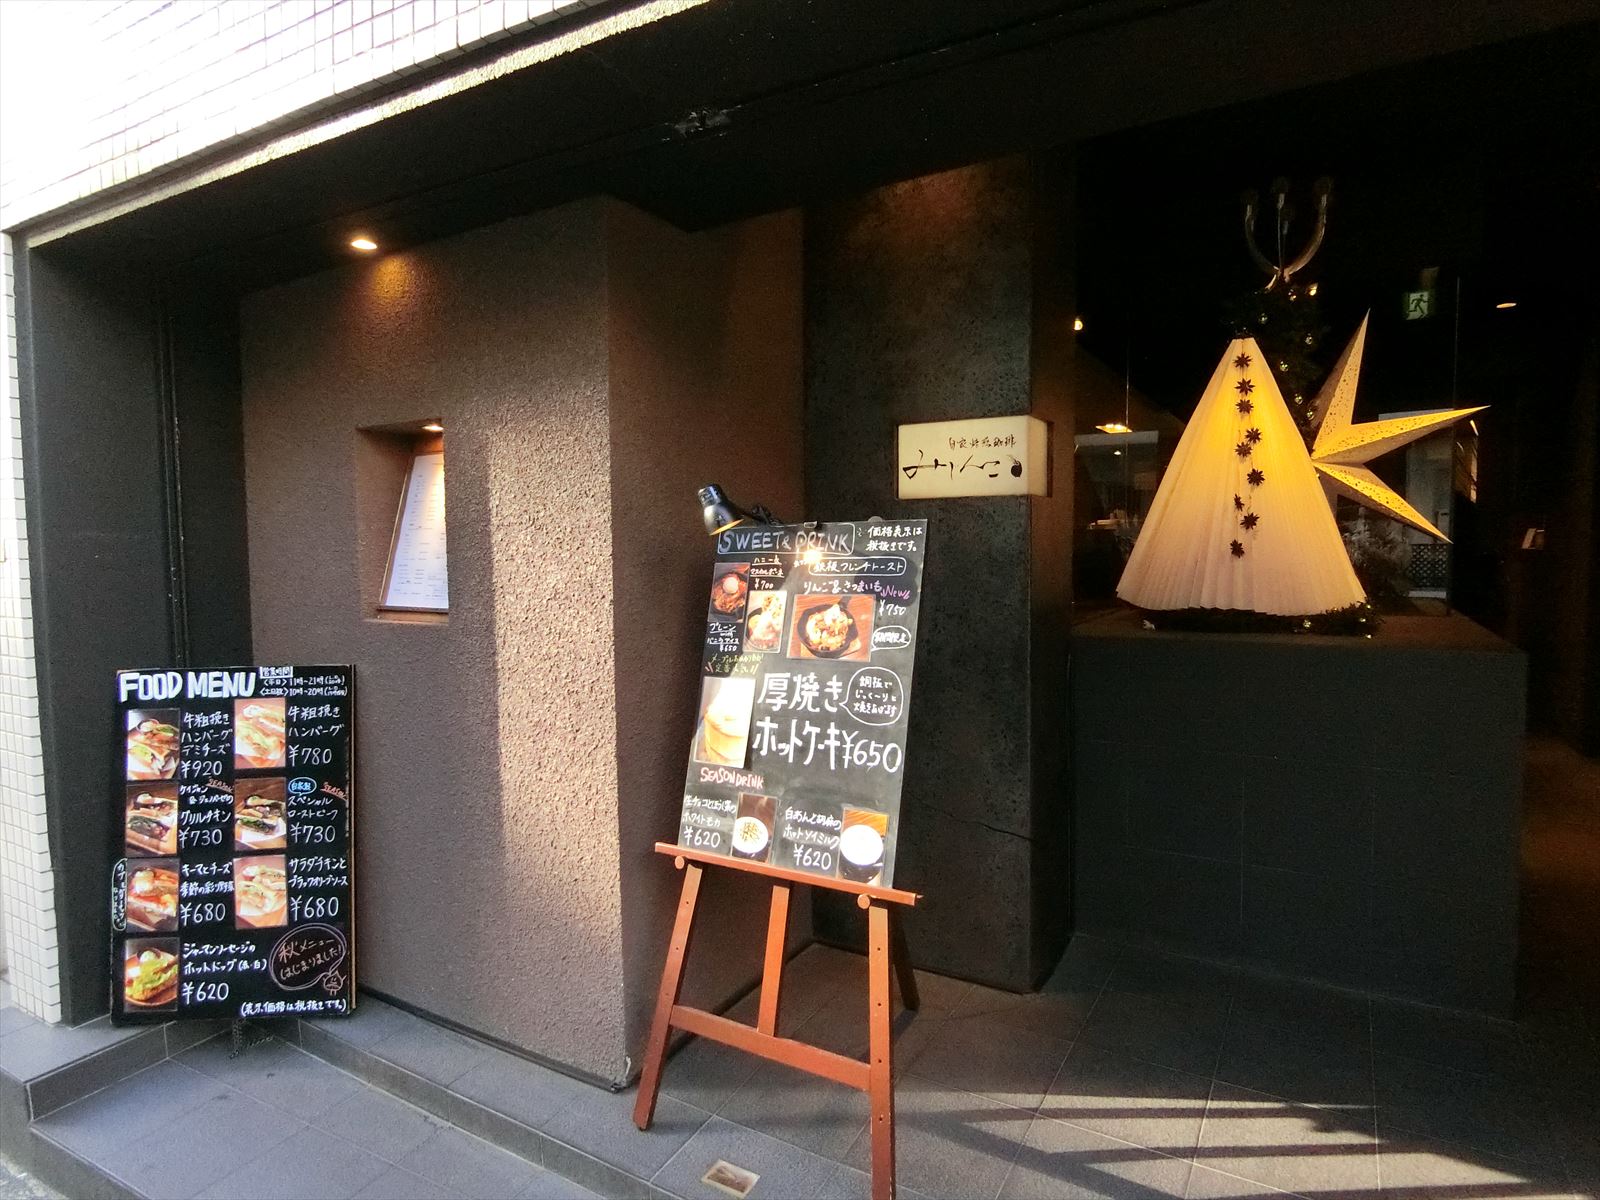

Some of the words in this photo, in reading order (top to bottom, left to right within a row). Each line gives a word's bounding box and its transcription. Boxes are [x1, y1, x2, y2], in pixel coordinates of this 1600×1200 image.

[719, 531, 784, 553] SWEET
[795, 530, 852, 553] DRINK
[878, 599, 907, 617] ¥750
[119, 672, 183, 703] FOOD
[187, 671, 257, 700] MENU
[757, 672, 843, 713] 厚焼き
[183, 711, 231, 729] 牛粗挽き
[287, 704, 341, 722] 牛粗挽き
[181, 728, 234, 743] ハンバーグ
[288, 723, 345, 737] ハンバーグ
[288, 744, 333, 768] ¥780
[752, 716, 842, 771] ホットケーキ
[842, 730, 902, 773] ¥650
[180, 760, 223, 779] ¥920
[700, 767, 736, 784] SEASON
[735, 773, 765, 790] DRINK
[180, 808, 232, 826] グリルチキン
[287, 809, 339, 821] ローストビーフ
[179, 826, 223, 849] ¥730
[290, 821, 336, 844] ¥730
[683, 825, 721, 848] ¥620
[288, 856, 347, 874] サラダチキンと
[793, 843, 832, 870] ¥620
[181, 862, 233, 877] キーマとチーズ
[180, 903, 226, 927] ¥680
[290, 895, 340, 922] ¥680
[181, 982, 230, 1006] ¥620
